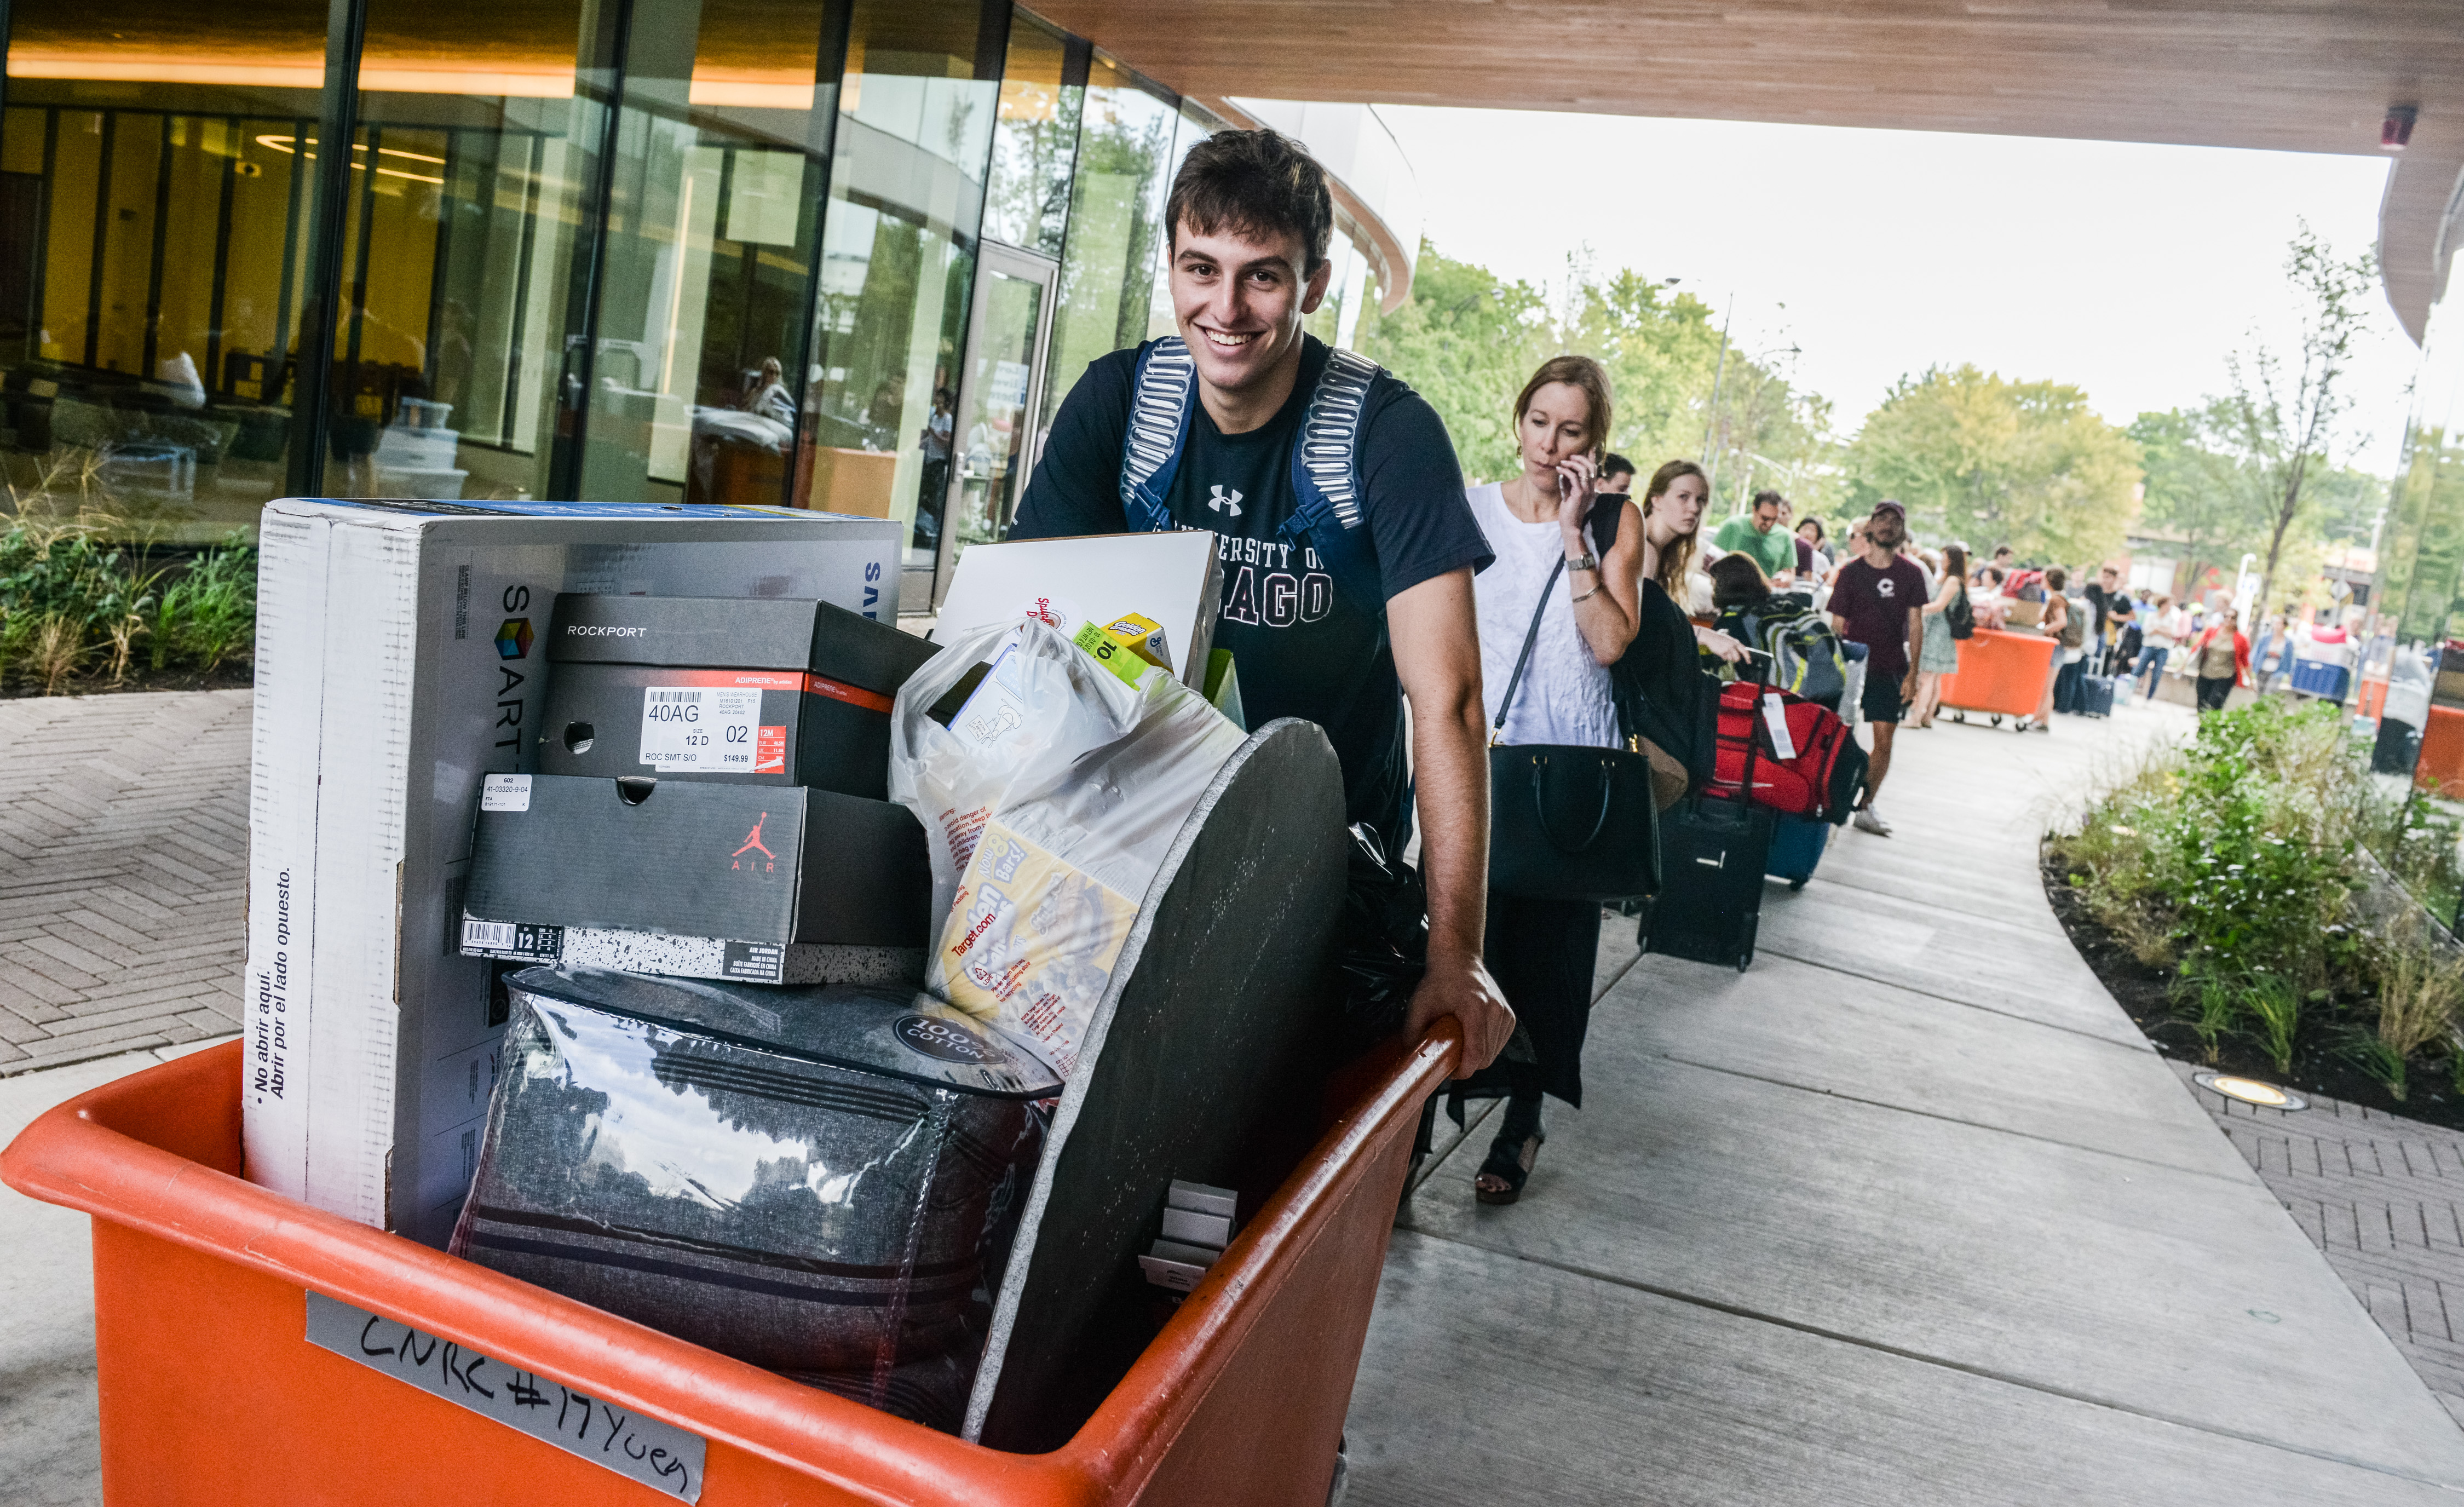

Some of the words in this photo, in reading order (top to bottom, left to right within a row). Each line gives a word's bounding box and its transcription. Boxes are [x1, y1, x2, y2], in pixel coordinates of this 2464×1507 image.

[1218, 566, 1333, 627] AGO
[567, 626, 647, 637] ROCKPORT
[1085, 626, 1094, 635] NET
[1109, 625, 1139, 636] Grahams
[1114, 620, 1147, 634] Golden
[1097, 641, 1118, 660] 10
[648, 705, 699, 722] 40AG
[686, 736, 697, 745] 12
[701, 736, 709, 745] D
[726, 726, 748, 743] 02
[645, 753, 663, 761] ROC
[724, 755, 749, 763] $149.99
[959, 810, 979, 821] danger
[971, 816, 985, 824] keep
[954, 831, 967, 843] away
[968, 825, 981, 833] from
[957, 835, 980, 848] children.
[958, 846, 970, 854] bag
[977, 848, 994, 880] Now
[987, 833, 1009, 858] 8
[732, 860, 774, 873] AIR
[956, 864, 965, 873] This
[995, 841, 1024, 882] Bars!
[277, 867, 291, 946] opuesto.
[953, 890, 969, 907] Padding
[519, 933, 534, 949] 12
[951, 913, 996, 957] Target.com
[273, 951, 288, 991] lado
[983, 974, 994, 985] LDPE
[1002, 970, 1024, 993] participating
[1021, 961, 1030, 971] store
[991, 981, 1003, 993] Please
[1001, 970, 1012, 982] return
[1005, 981, 1022, 998] recycling
[257, 970, 273, 1015] aquí.
[273, 996, 285, 1013] el
[1027, 1005, 1037, 1014] Target
[1032, 1011, 1045, 1025] registered
[1044, 999, 1058, 1013] trademarks
[1034, 1006, 1044, 1015] Design
[1046, 994, 1056, 1002] Target
[1046, 1014, 1057, 1026] reserved.
[1052, 1022, 1063, 1034] Thailand
[256, 1018, 268, 1061] abrir
[273, 1017, 287, 1050] por
[912, 1019, 995, 1057] 100%
[907, 1028, 985, 1059] COTTON
[255, 1067, 268, 1093] No
[271, 1052, 284, 1100] Abrir
[360, 1315, 494, 1399] CNRC
